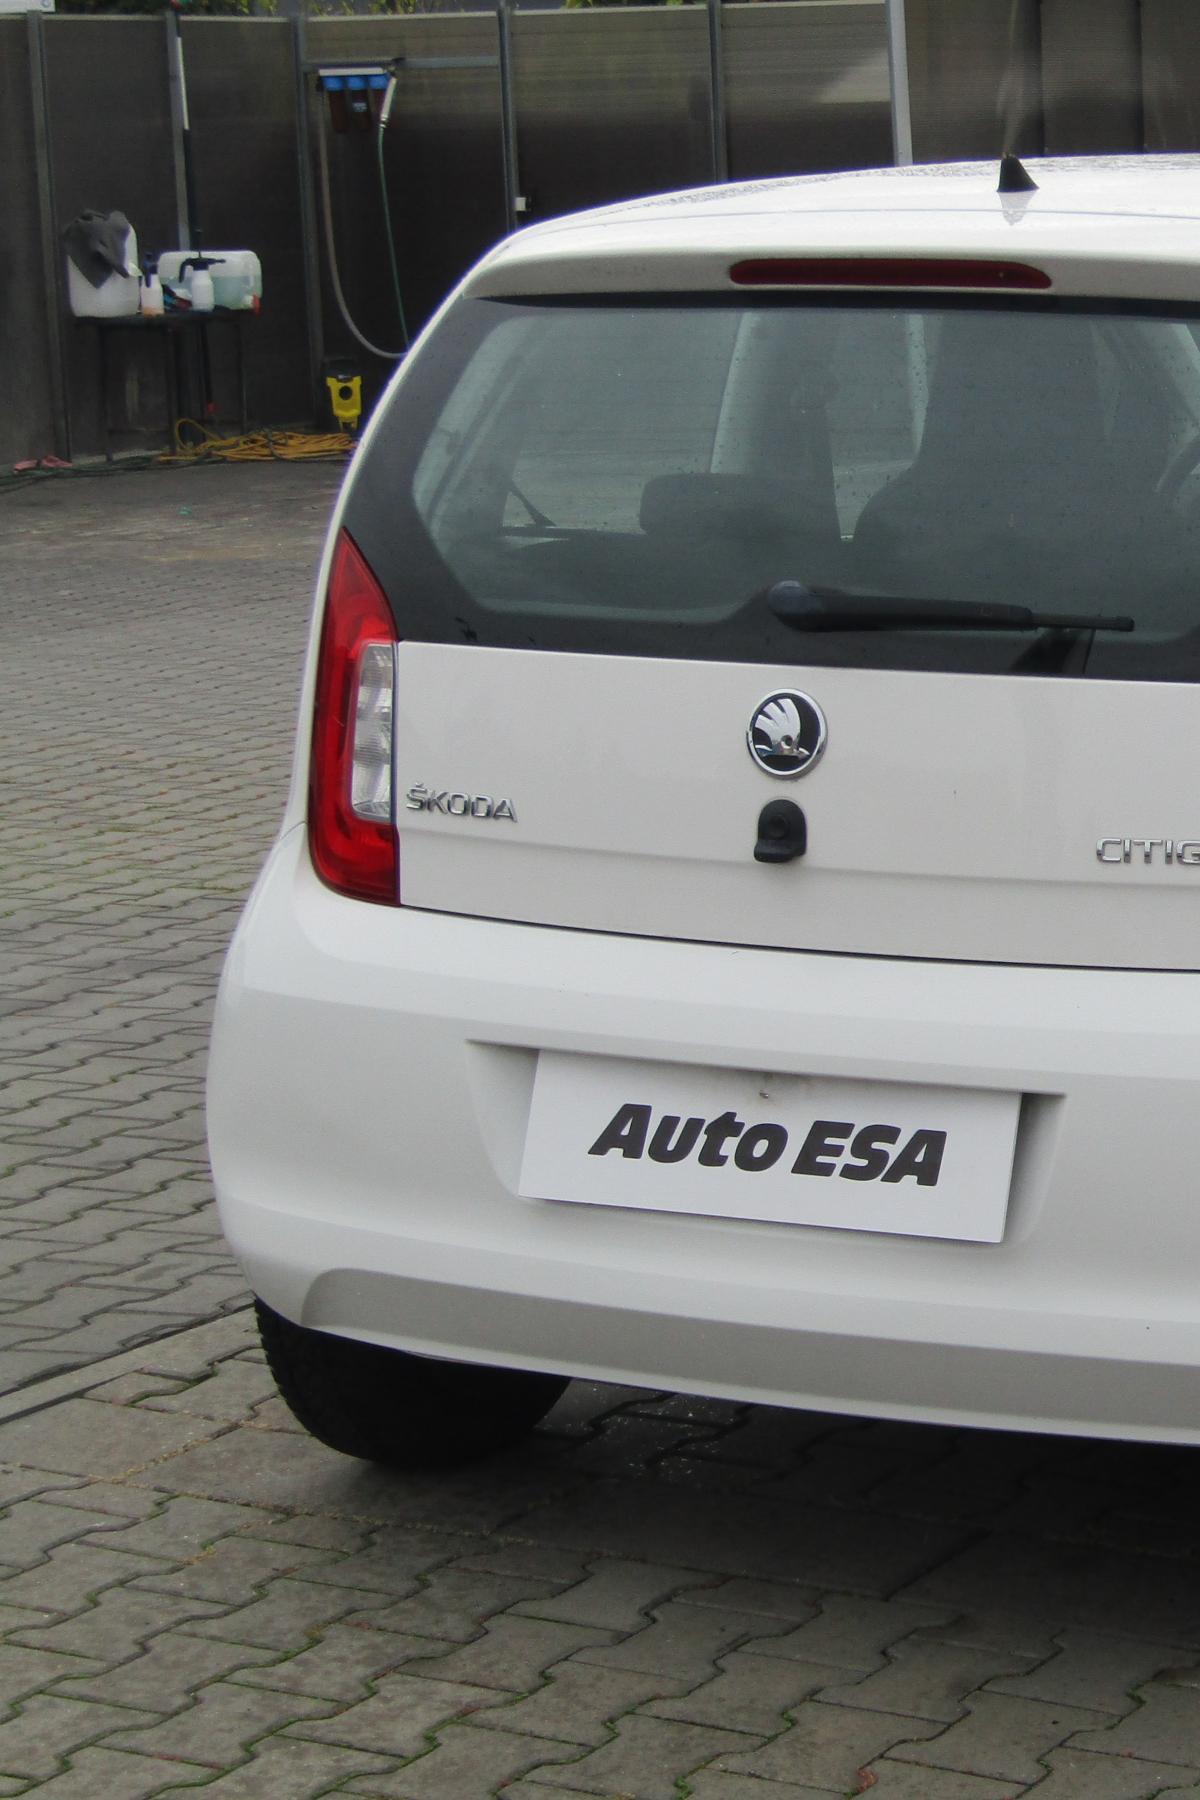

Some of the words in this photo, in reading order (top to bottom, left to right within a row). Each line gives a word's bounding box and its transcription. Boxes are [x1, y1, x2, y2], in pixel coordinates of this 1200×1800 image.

[406, 782, 518, 823] ŠKODA
[587, 1103, 789, 1172] Auto
[790, 1120, 947, 1187] ESA
